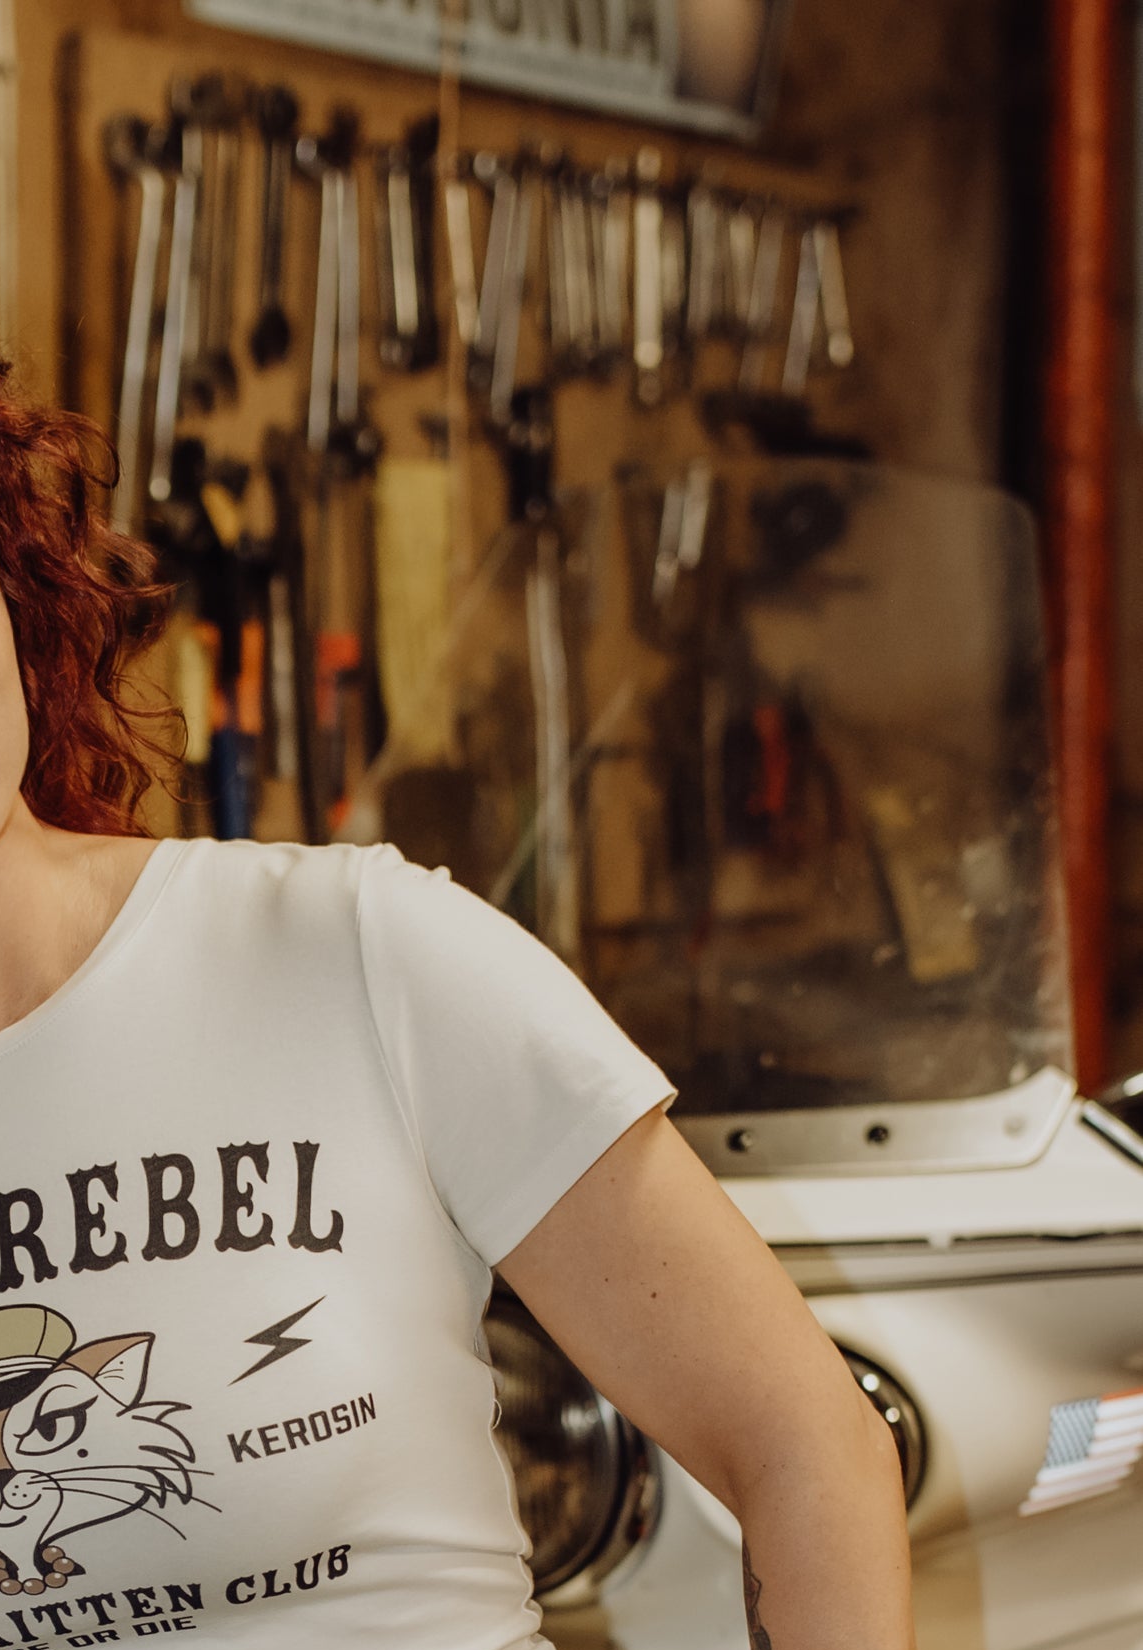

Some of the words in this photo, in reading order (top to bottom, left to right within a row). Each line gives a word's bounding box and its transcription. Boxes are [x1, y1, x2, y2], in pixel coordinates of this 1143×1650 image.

[227, 1393, 377, 1463] KEROSIN
[225, 1544, 351, 1605] CLUB
[66, 1630, 120, 1648] OR
[132, 1616, 197, 1637] DIE
